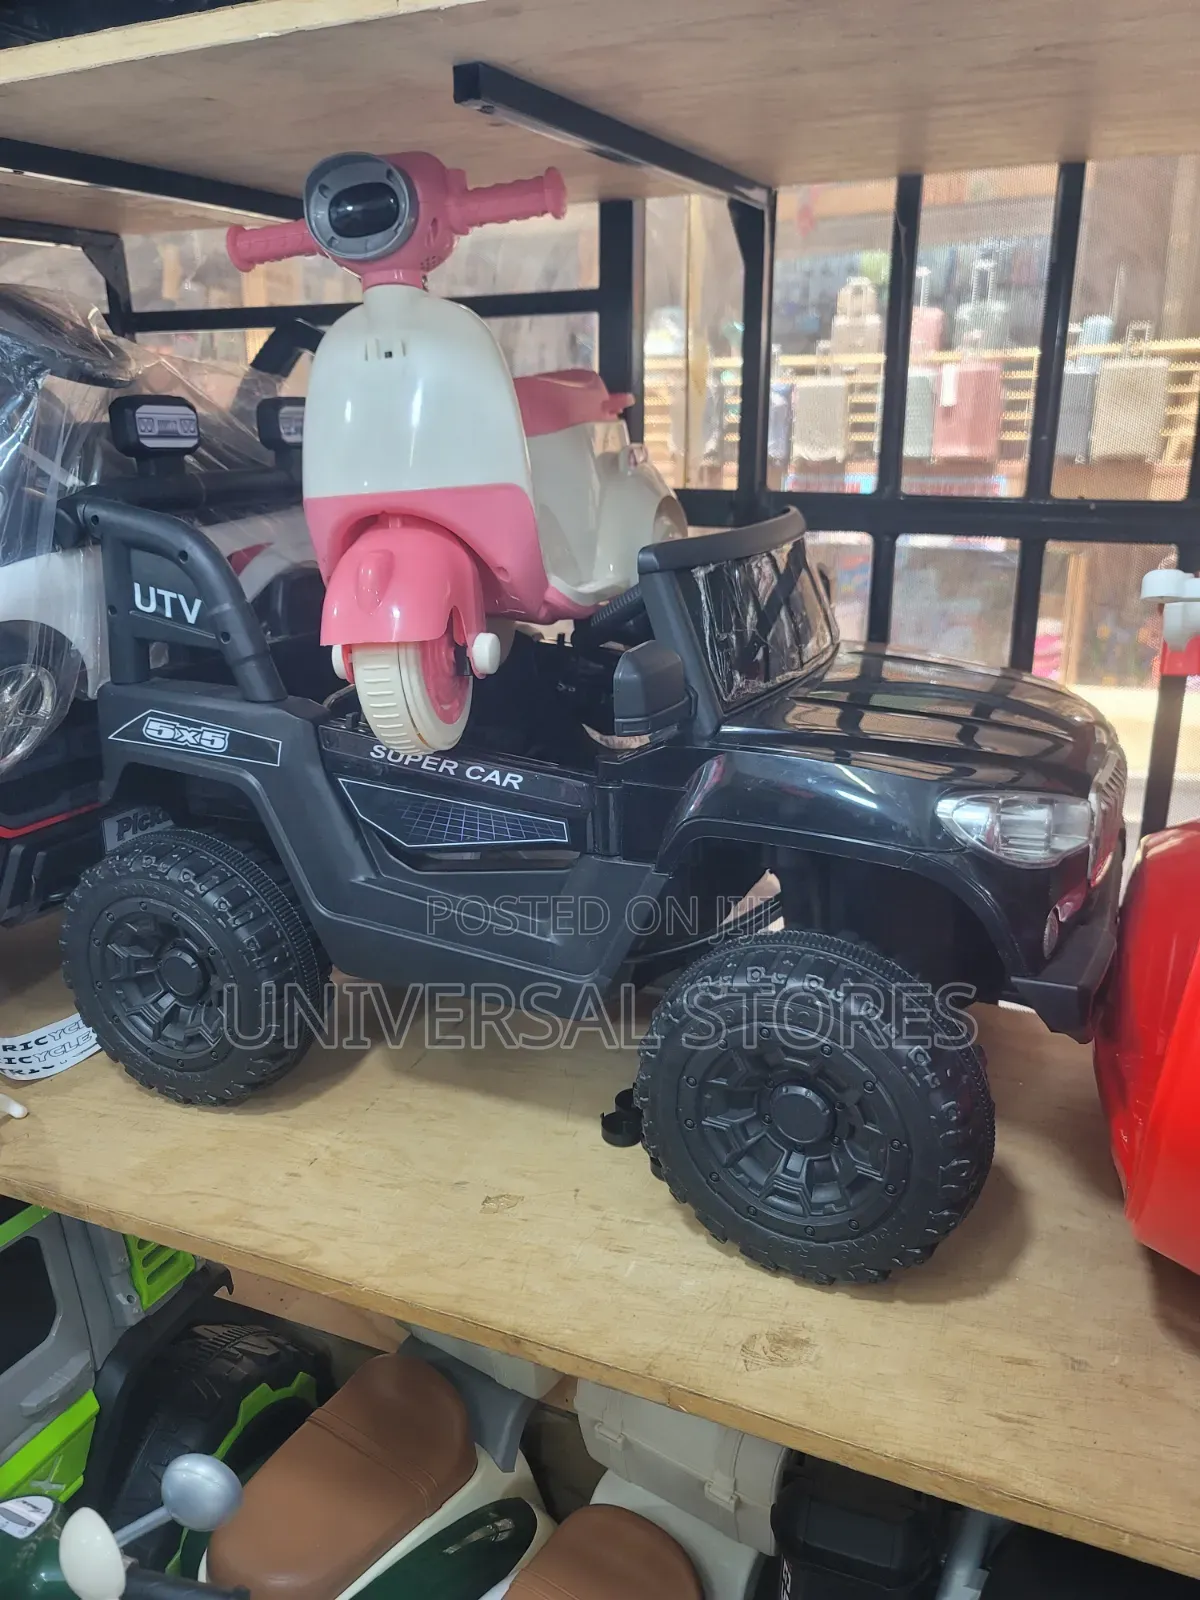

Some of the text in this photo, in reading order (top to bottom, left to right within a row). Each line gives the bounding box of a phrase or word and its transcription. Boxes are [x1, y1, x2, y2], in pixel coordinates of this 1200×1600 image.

[133, 581, 202, 624] UTV
[370, 744, 524, 790] SUPER CAR
